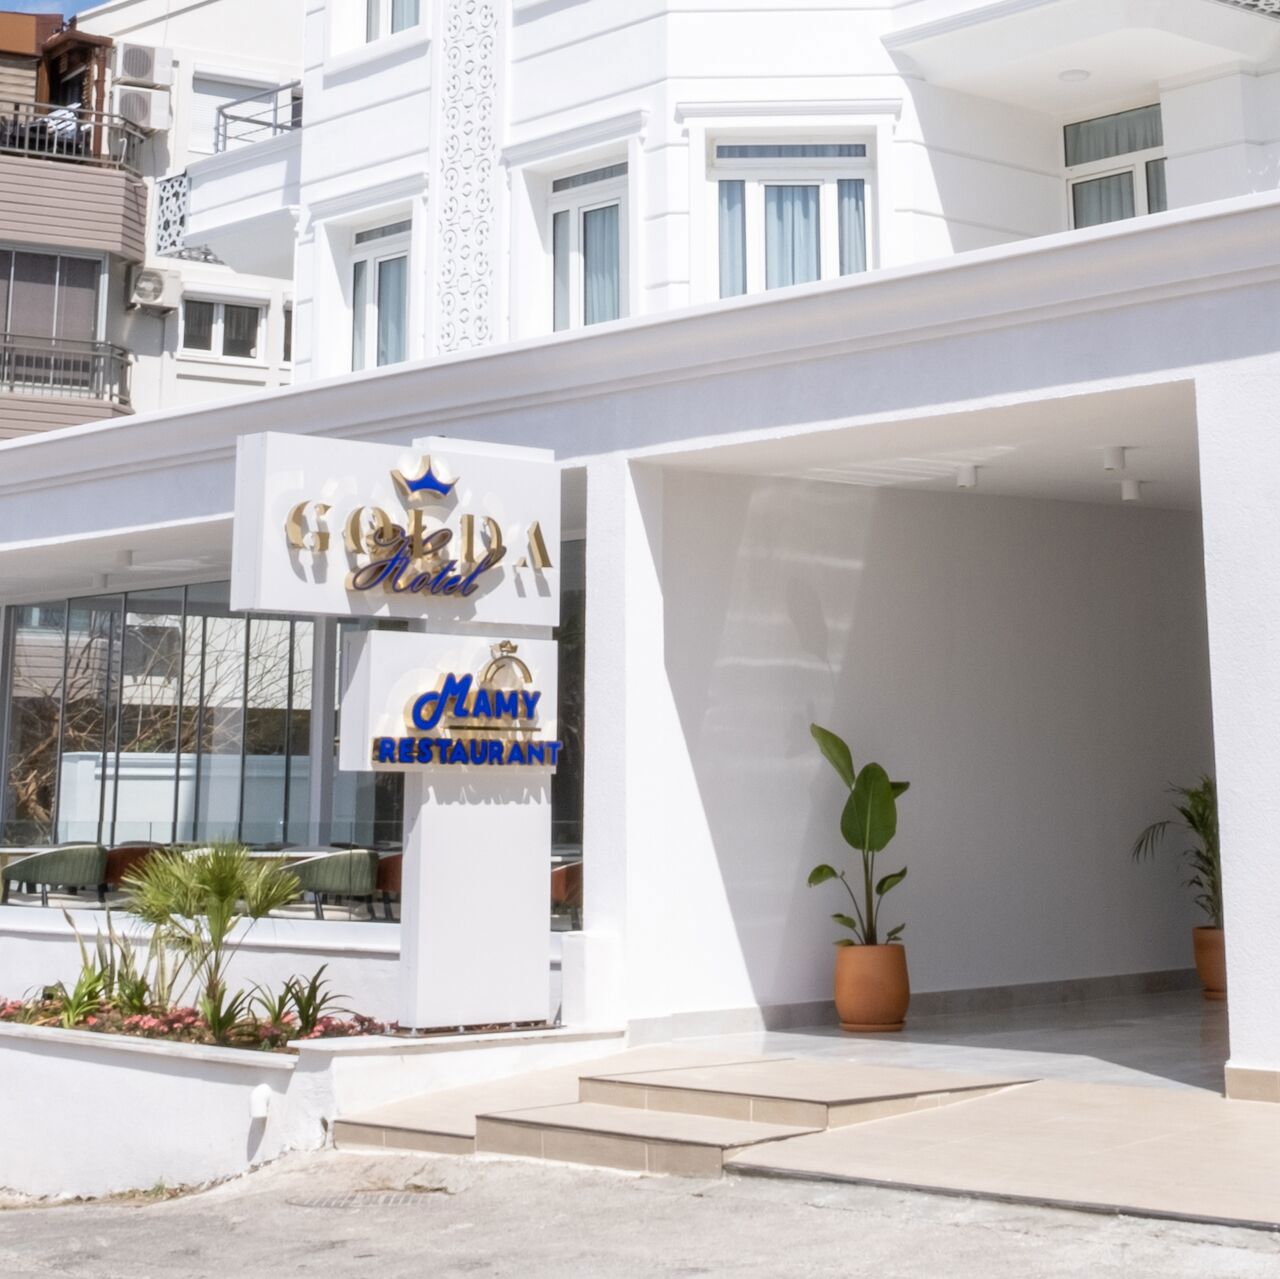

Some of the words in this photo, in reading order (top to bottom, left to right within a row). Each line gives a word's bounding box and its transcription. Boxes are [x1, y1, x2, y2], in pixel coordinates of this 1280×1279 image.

[285, 500, 553, 568] GOLDA
[353, 523, 507, 597] Hotel
[376, 736, 563, 766] RESTAURANT
